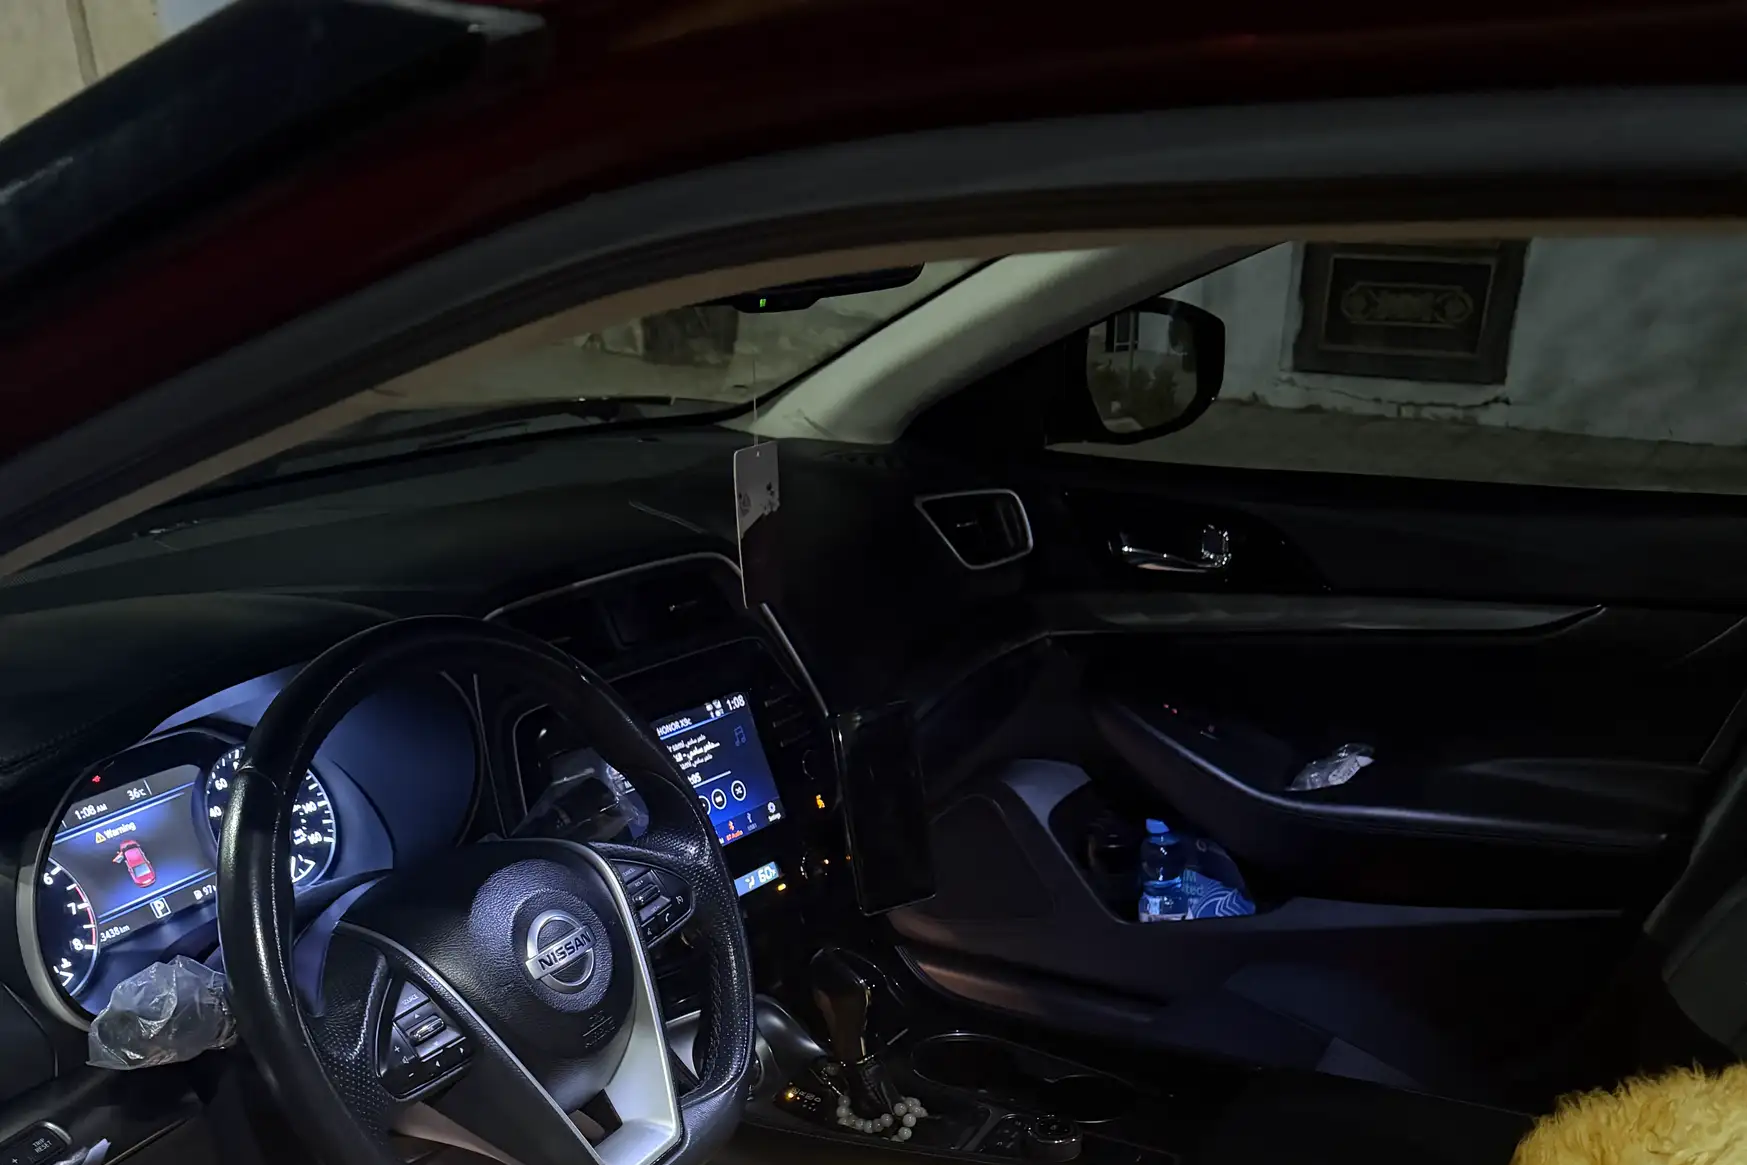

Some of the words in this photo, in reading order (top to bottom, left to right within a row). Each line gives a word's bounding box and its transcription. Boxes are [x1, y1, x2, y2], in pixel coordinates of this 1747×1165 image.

[726, 694, 746, 711] 1:08
[656, 721, 680, 736] HONOR
[214, 778, 228, 790] 60
[74, 804, 97, 820] 1:08
[96, 803, 108, 814] AM
[209, 805, 222, 818] 40
[301, 801, 317, 814] 140
[103, 822, 137, 839] Warning
[307, 831, 322, 845] 160
[43, 872, 54, 885] 6
[66, 902, 77, 916] 7
[118, 924, 131, 934] km
[71, 938, 84, 951] 8
[538, 931, 592, 970] NISSAN
[32, 1138, 45, 1147] TRIP
[35, 1140, 52, 1153] RESET
